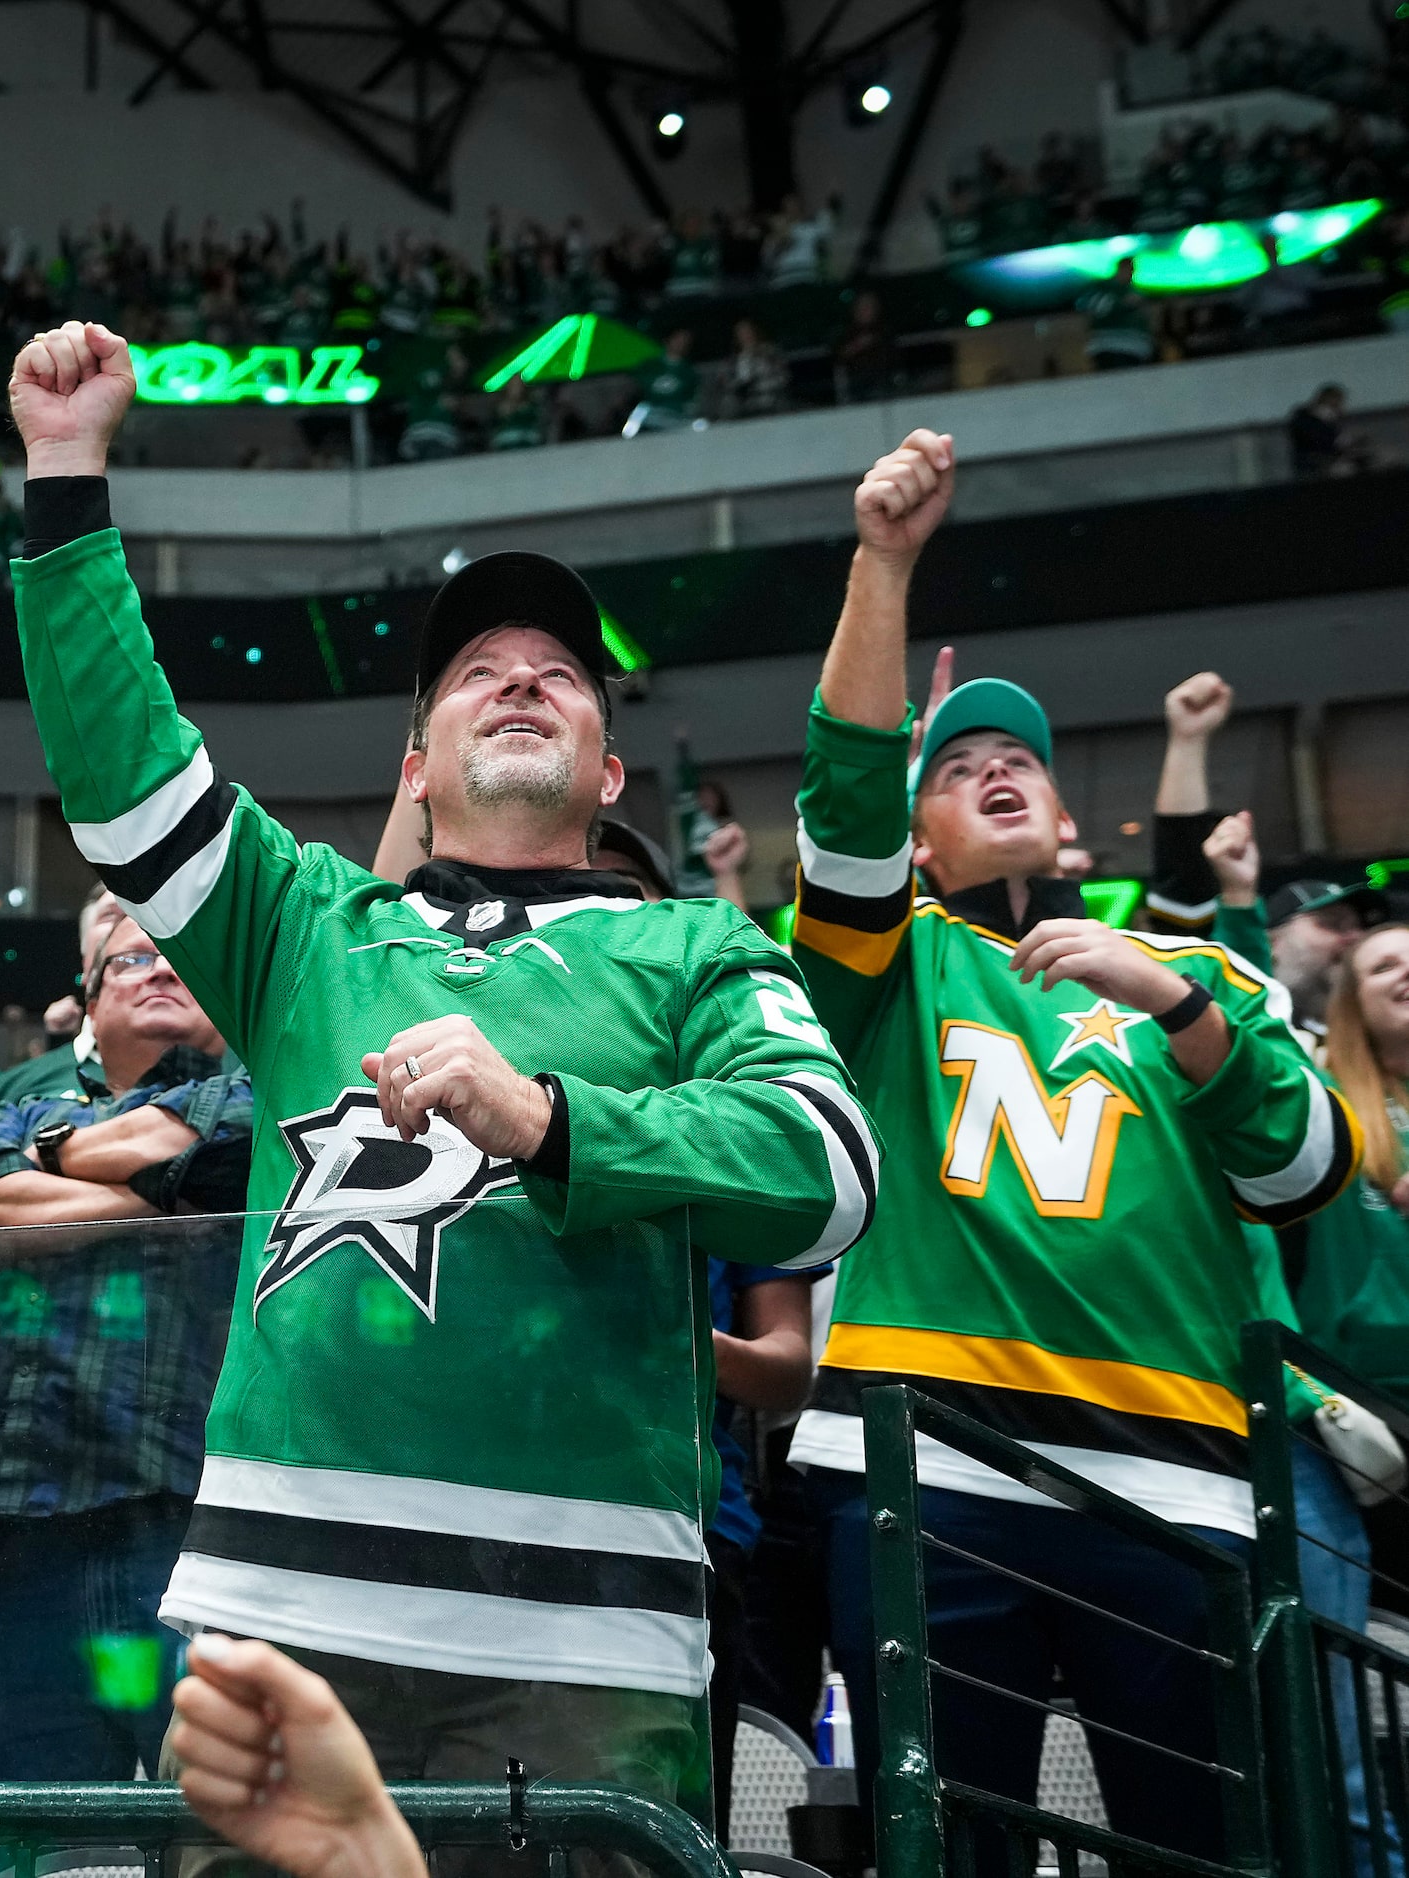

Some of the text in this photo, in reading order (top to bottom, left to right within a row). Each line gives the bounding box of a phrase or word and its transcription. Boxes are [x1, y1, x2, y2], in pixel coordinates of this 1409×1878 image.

[128, 341, 380, 404] OAL
[747, 967, 828, 1051] 2
[940, 1019, 1143, 1219] N
